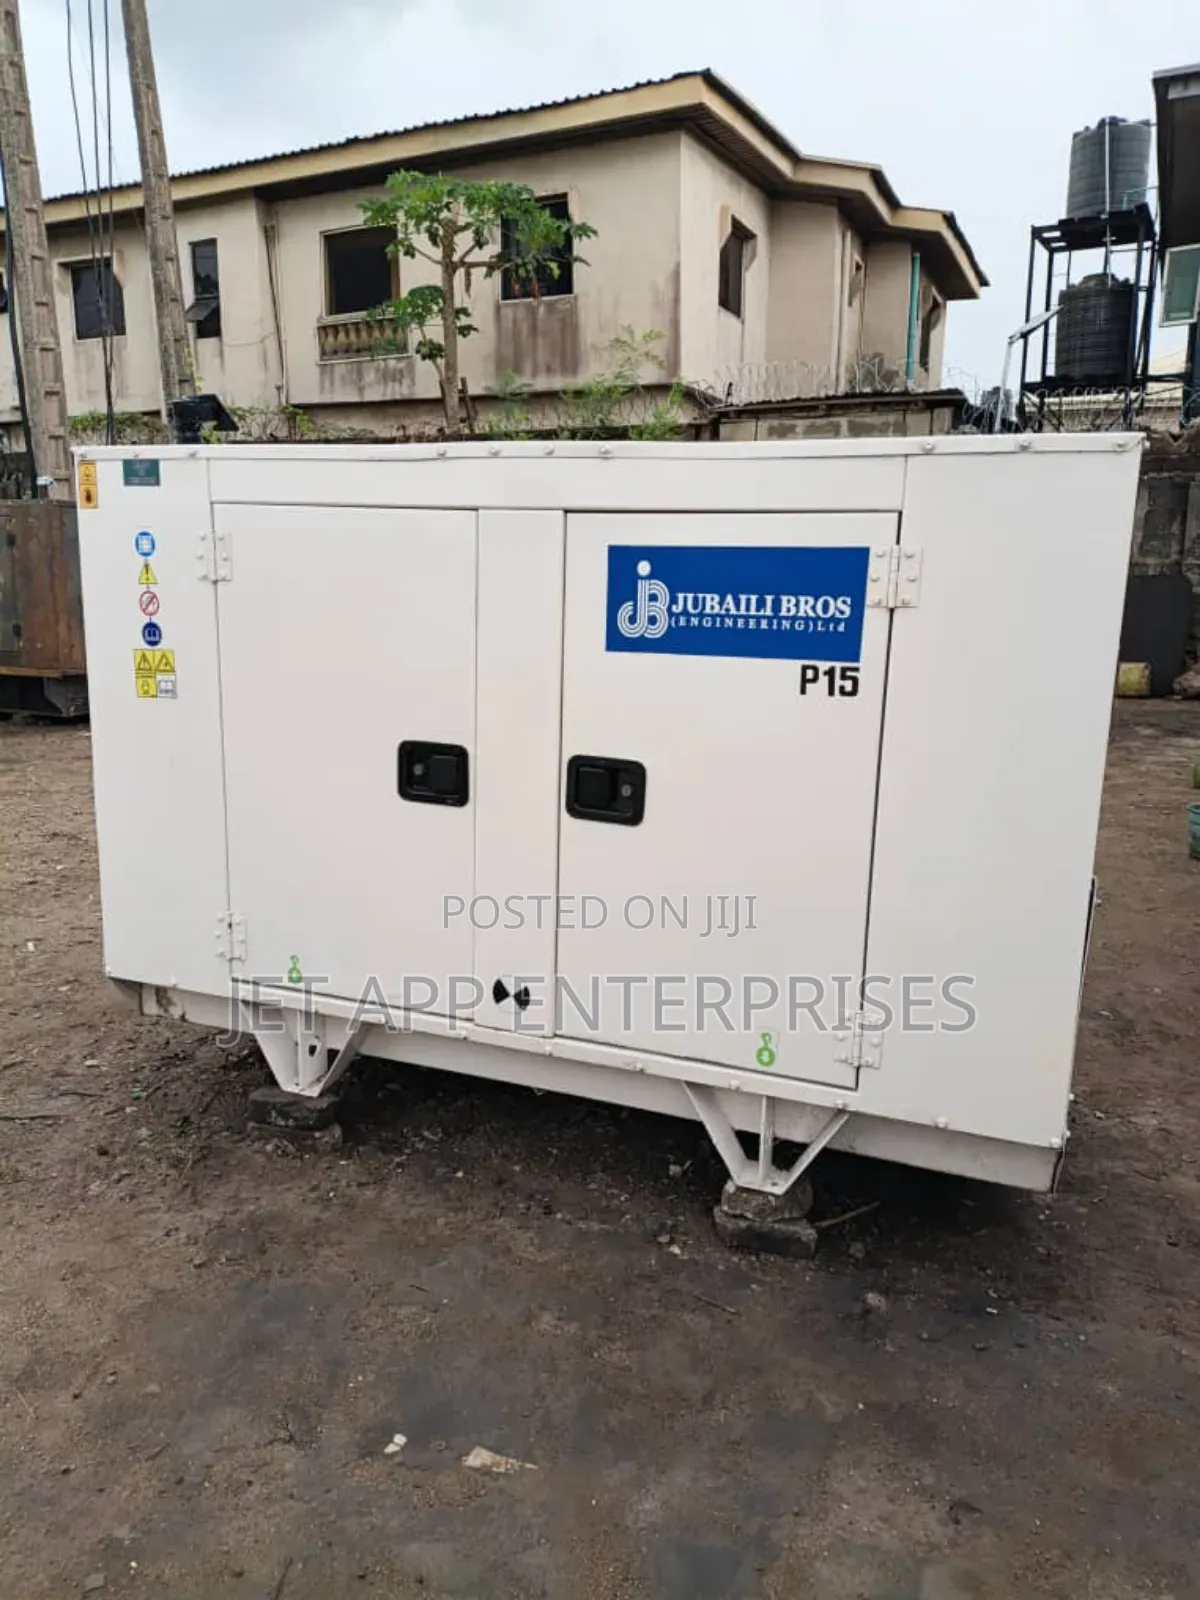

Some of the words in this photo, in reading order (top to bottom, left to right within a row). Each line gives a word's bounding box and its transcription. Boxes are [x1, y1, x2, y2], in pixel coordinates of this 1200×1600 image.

[671, 592, 774, 616] JUBAILI
[778, 594, 852, 618] BROS
[799, 663, 860, 697] P15
